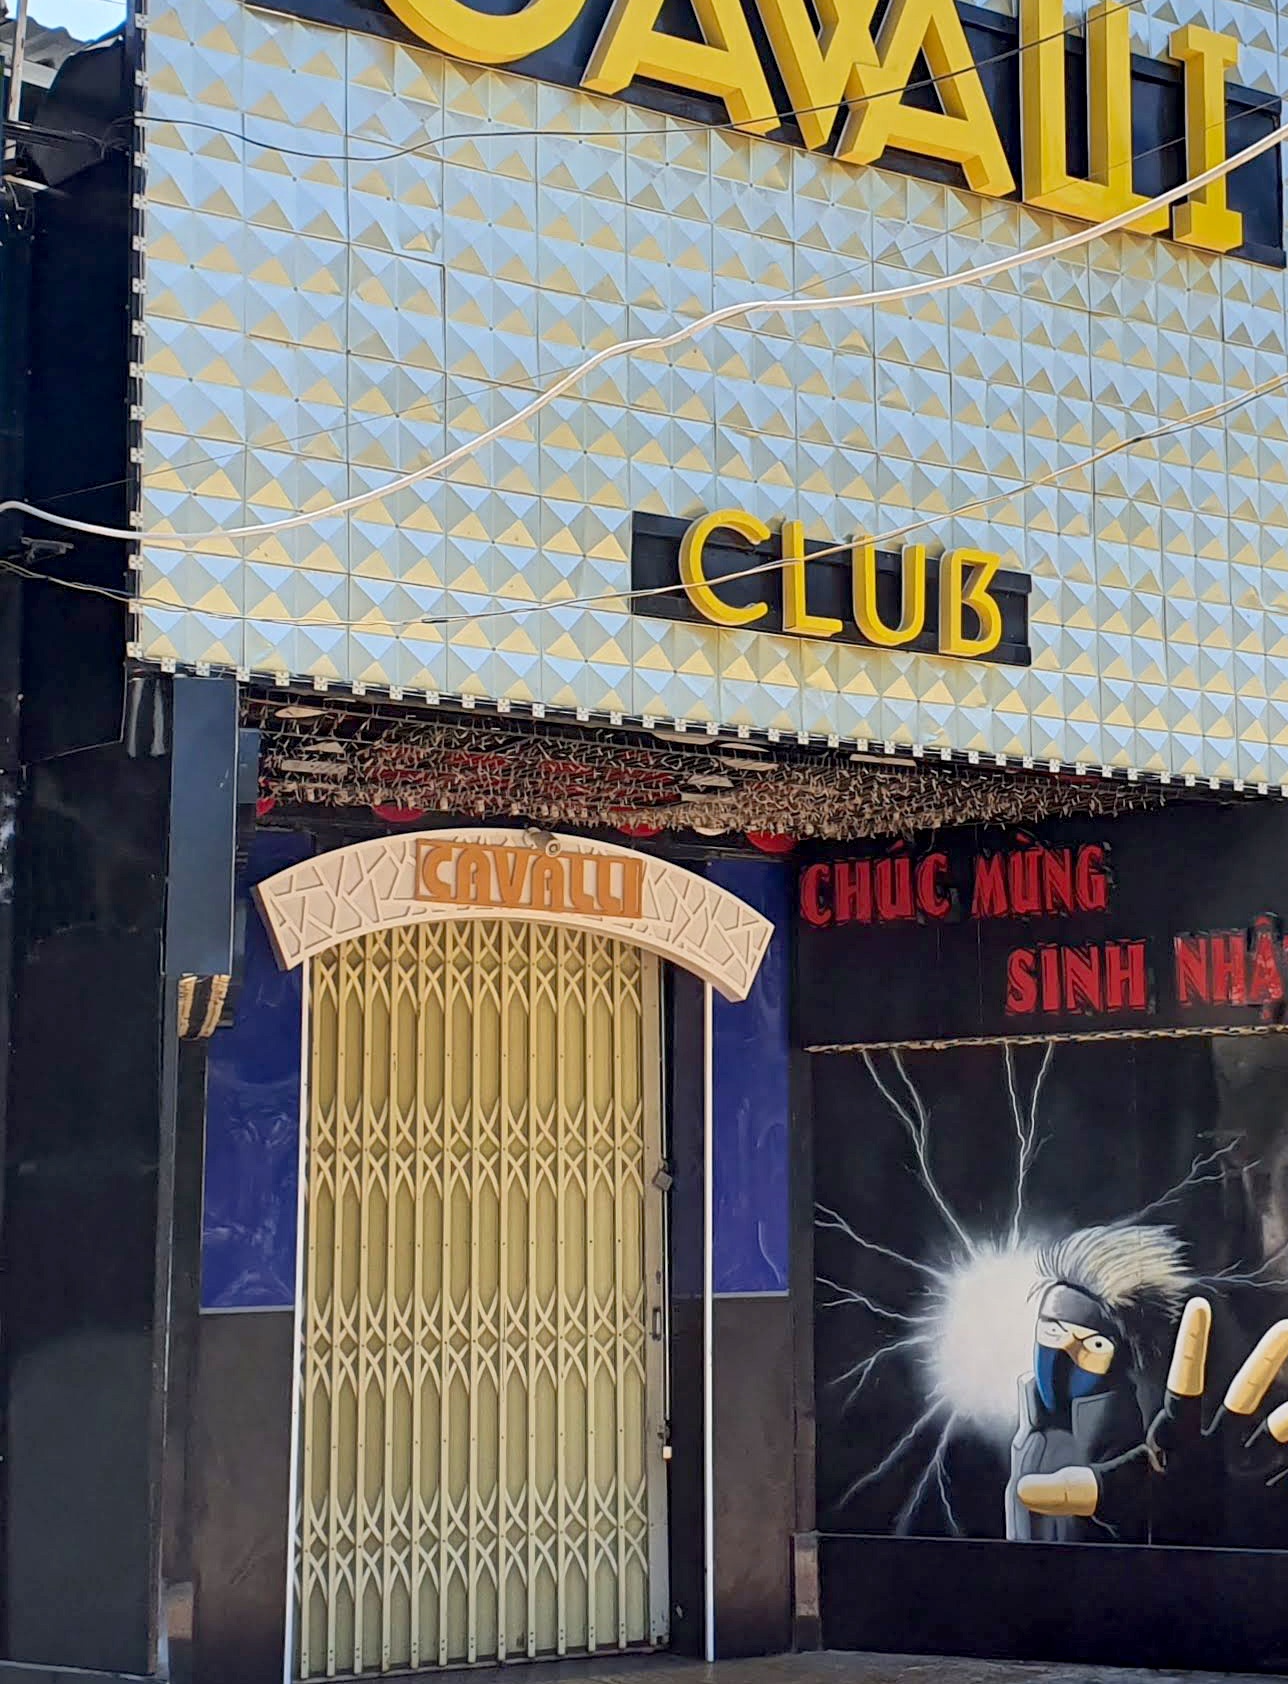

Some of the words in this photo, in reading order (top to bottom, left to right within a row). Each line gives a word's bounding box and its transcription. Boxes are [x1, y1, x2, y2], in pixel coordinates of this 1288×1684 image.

[384, 0, 1243, 254] AVALLI
[679, 509, 1002, 657] CLUB
[420, 843, 640, 917] CAVALLI
[800, 839, 952, 927] CHÚC
[1005, 937, 1147, 1016] SINH
